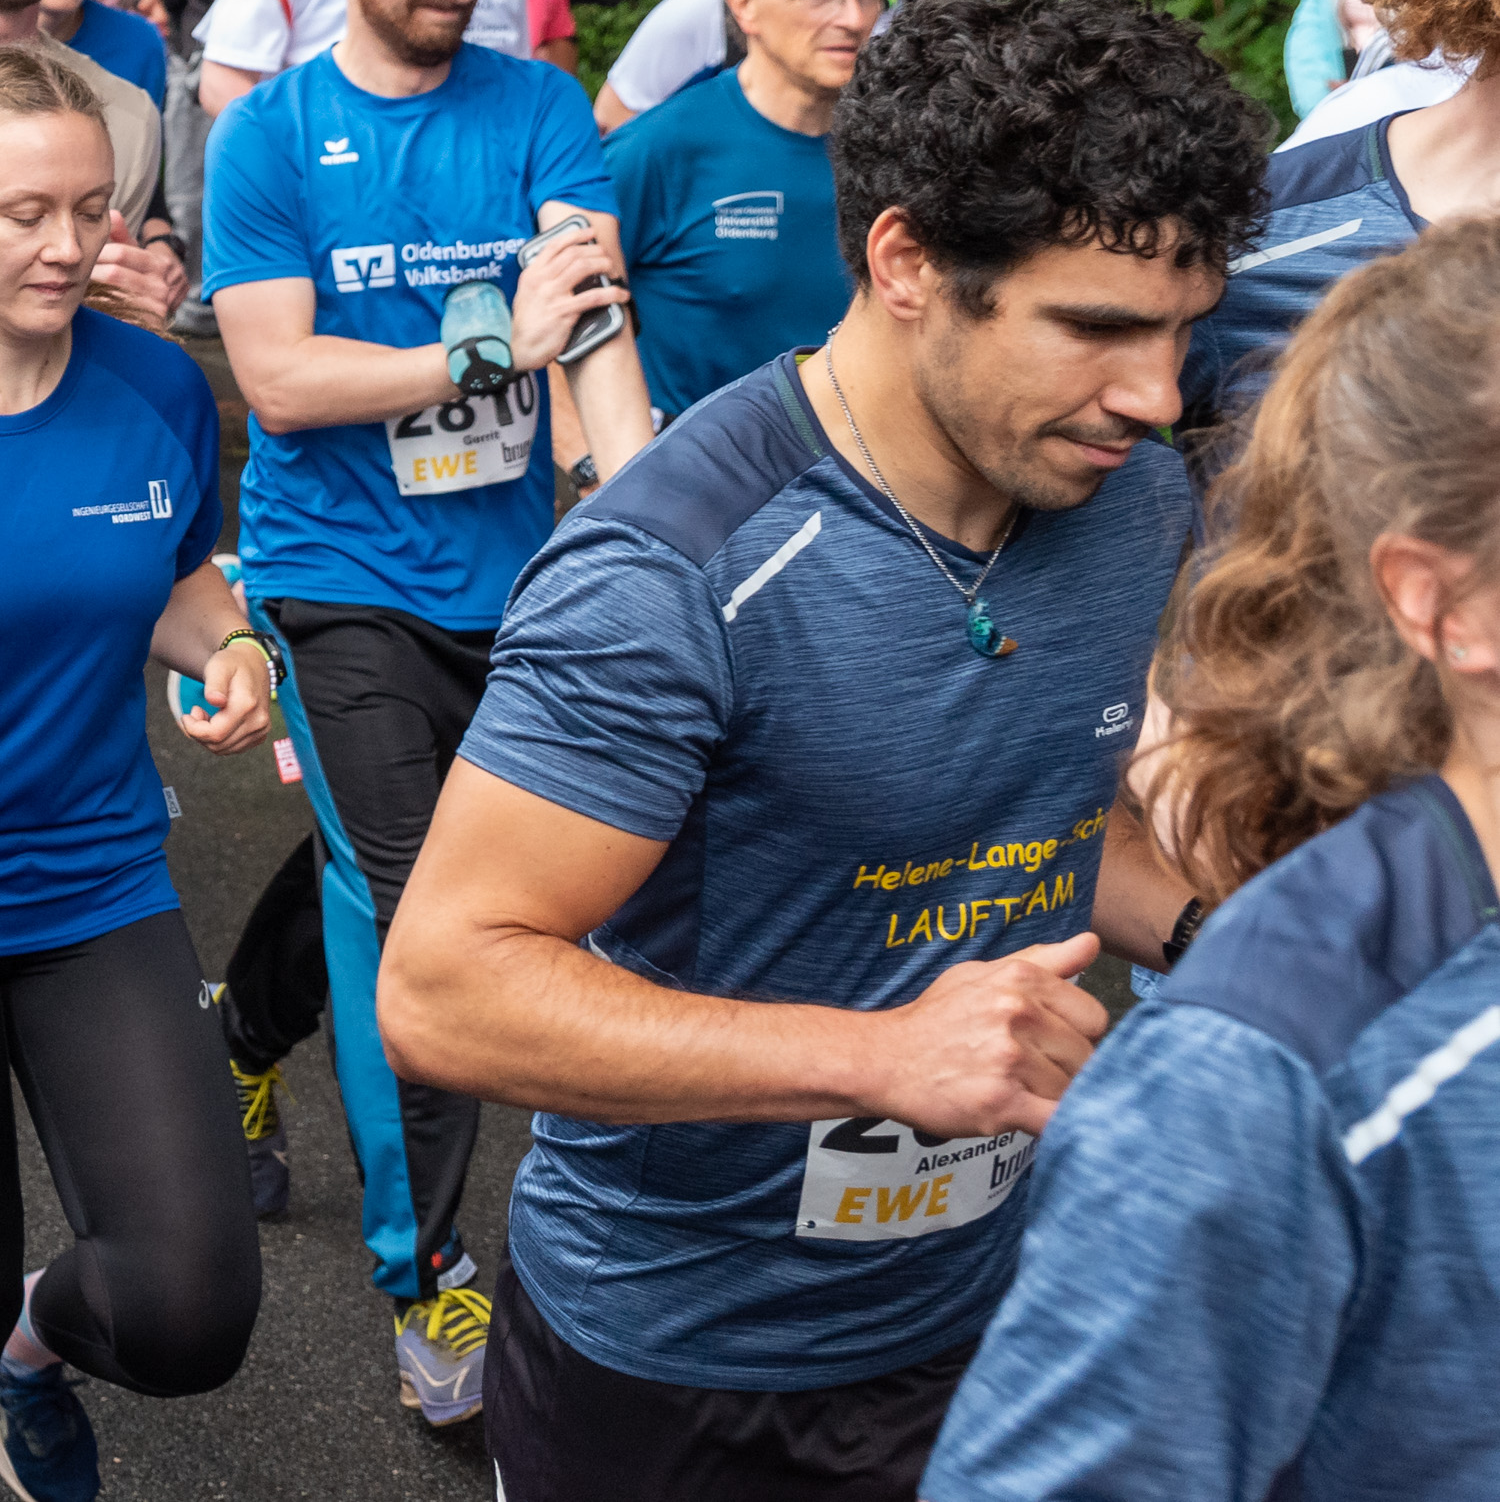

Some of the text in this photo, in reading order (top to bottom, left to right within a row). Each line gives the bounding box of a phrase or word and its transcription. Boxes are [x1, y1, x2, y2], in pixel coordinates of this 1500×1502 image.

[401, 237, 527, 263] Oldenburger
[404, 261, 503, 288] Volksbank
[413, 449, 478, 483] EWE
[111, 511, 151, 524] NORDWEST
[852, 807, 1106, 891] Helene-Lange-Sch
[914, 1130, 1016, 1176] Alexander
[833, 1172, 954, 1225] EWE
[990, 1142, 1033, 1190] bru
